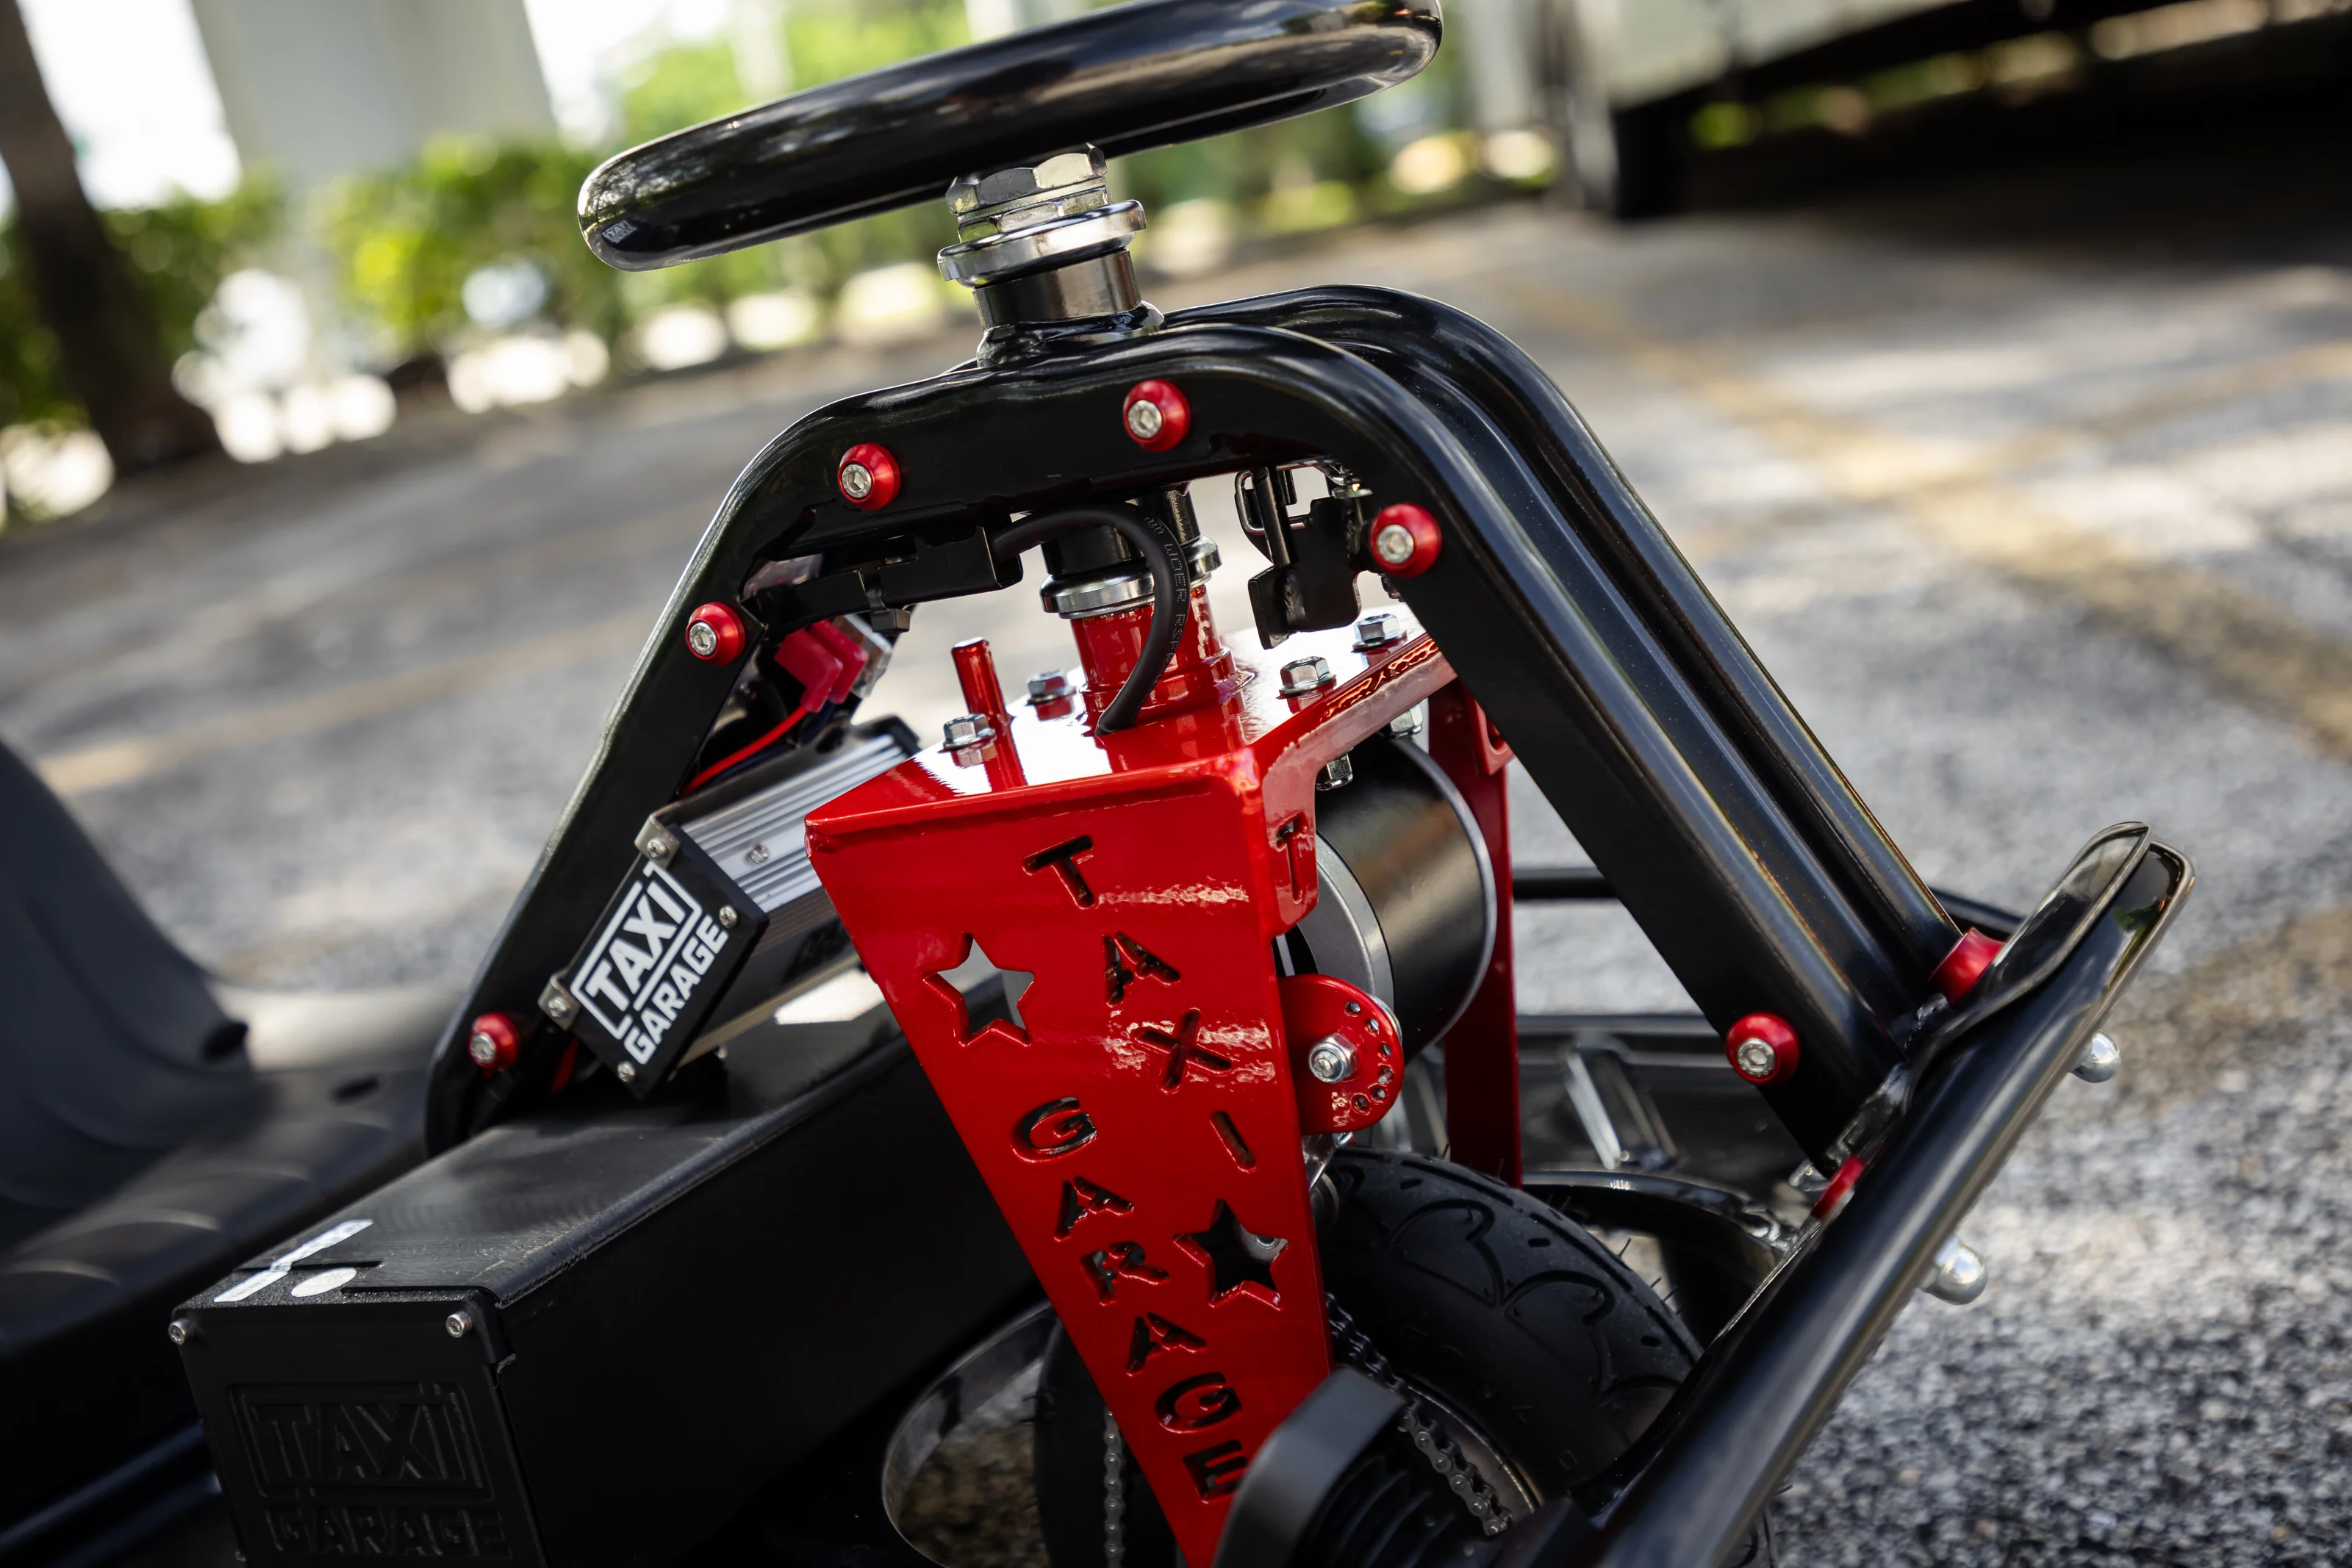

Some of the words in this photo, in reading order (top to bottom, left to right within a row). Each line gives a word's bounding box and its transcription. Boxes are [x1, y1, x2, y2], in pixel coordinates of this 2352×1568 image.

[585, 880, 686, 1012] TAXI
[623, 914, 729, 1065] GARAGE
[1022, 835, 1257, 1173] TAXI
[1010, 1096, 1250, 1506] GARAGE
[251, 1403, 468, 1481] TAXI
[264, 1506, 514, 1559] GARAGE
